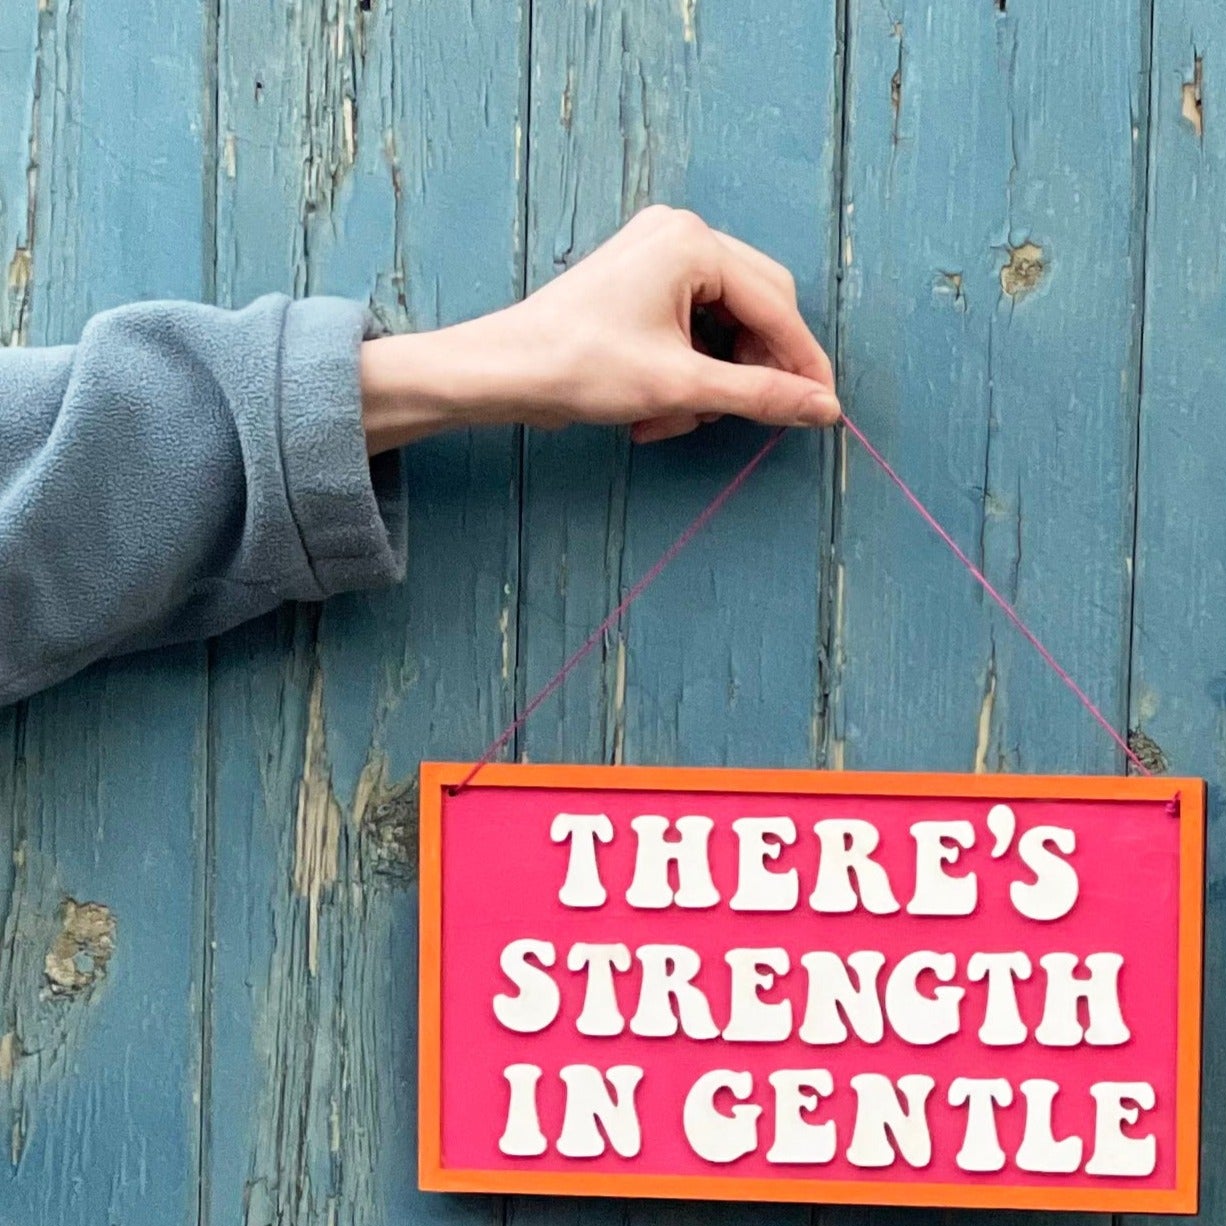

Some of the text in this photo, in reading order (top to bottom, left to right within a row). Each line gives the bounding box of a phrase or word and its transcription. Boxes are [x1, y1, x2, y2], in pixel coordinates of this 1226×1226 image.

[550, 803, 1079, 921] THERE'S
[492, 938, 1131, 1047] STRENGTH
[499, 1063, 1157, 1176] IN GENTLE
